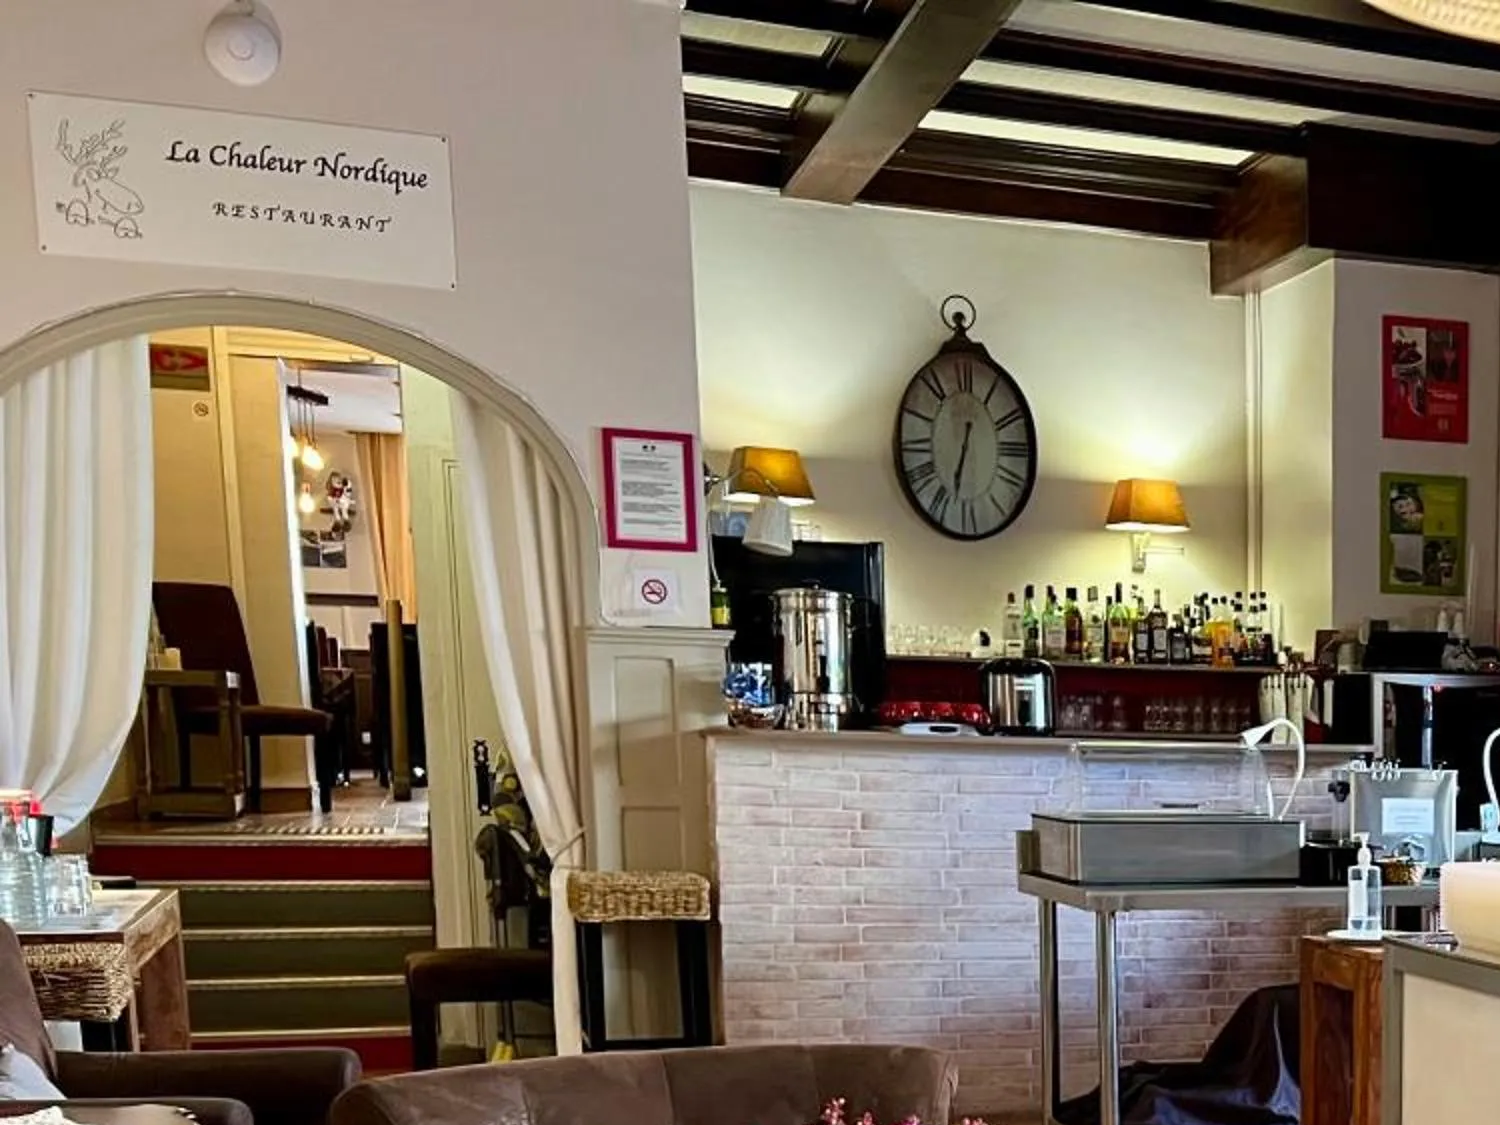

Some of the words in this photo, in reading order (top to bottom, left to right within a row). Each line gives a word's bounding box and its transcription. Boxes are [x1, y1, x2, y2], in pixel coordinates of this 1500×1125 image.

[166, 141, 201, 163] La
[209, 142, 307, 174] Chaleur
[314, 153, 429, 195] Nordique
[212, 202, 392, 232] RESTAURANT
